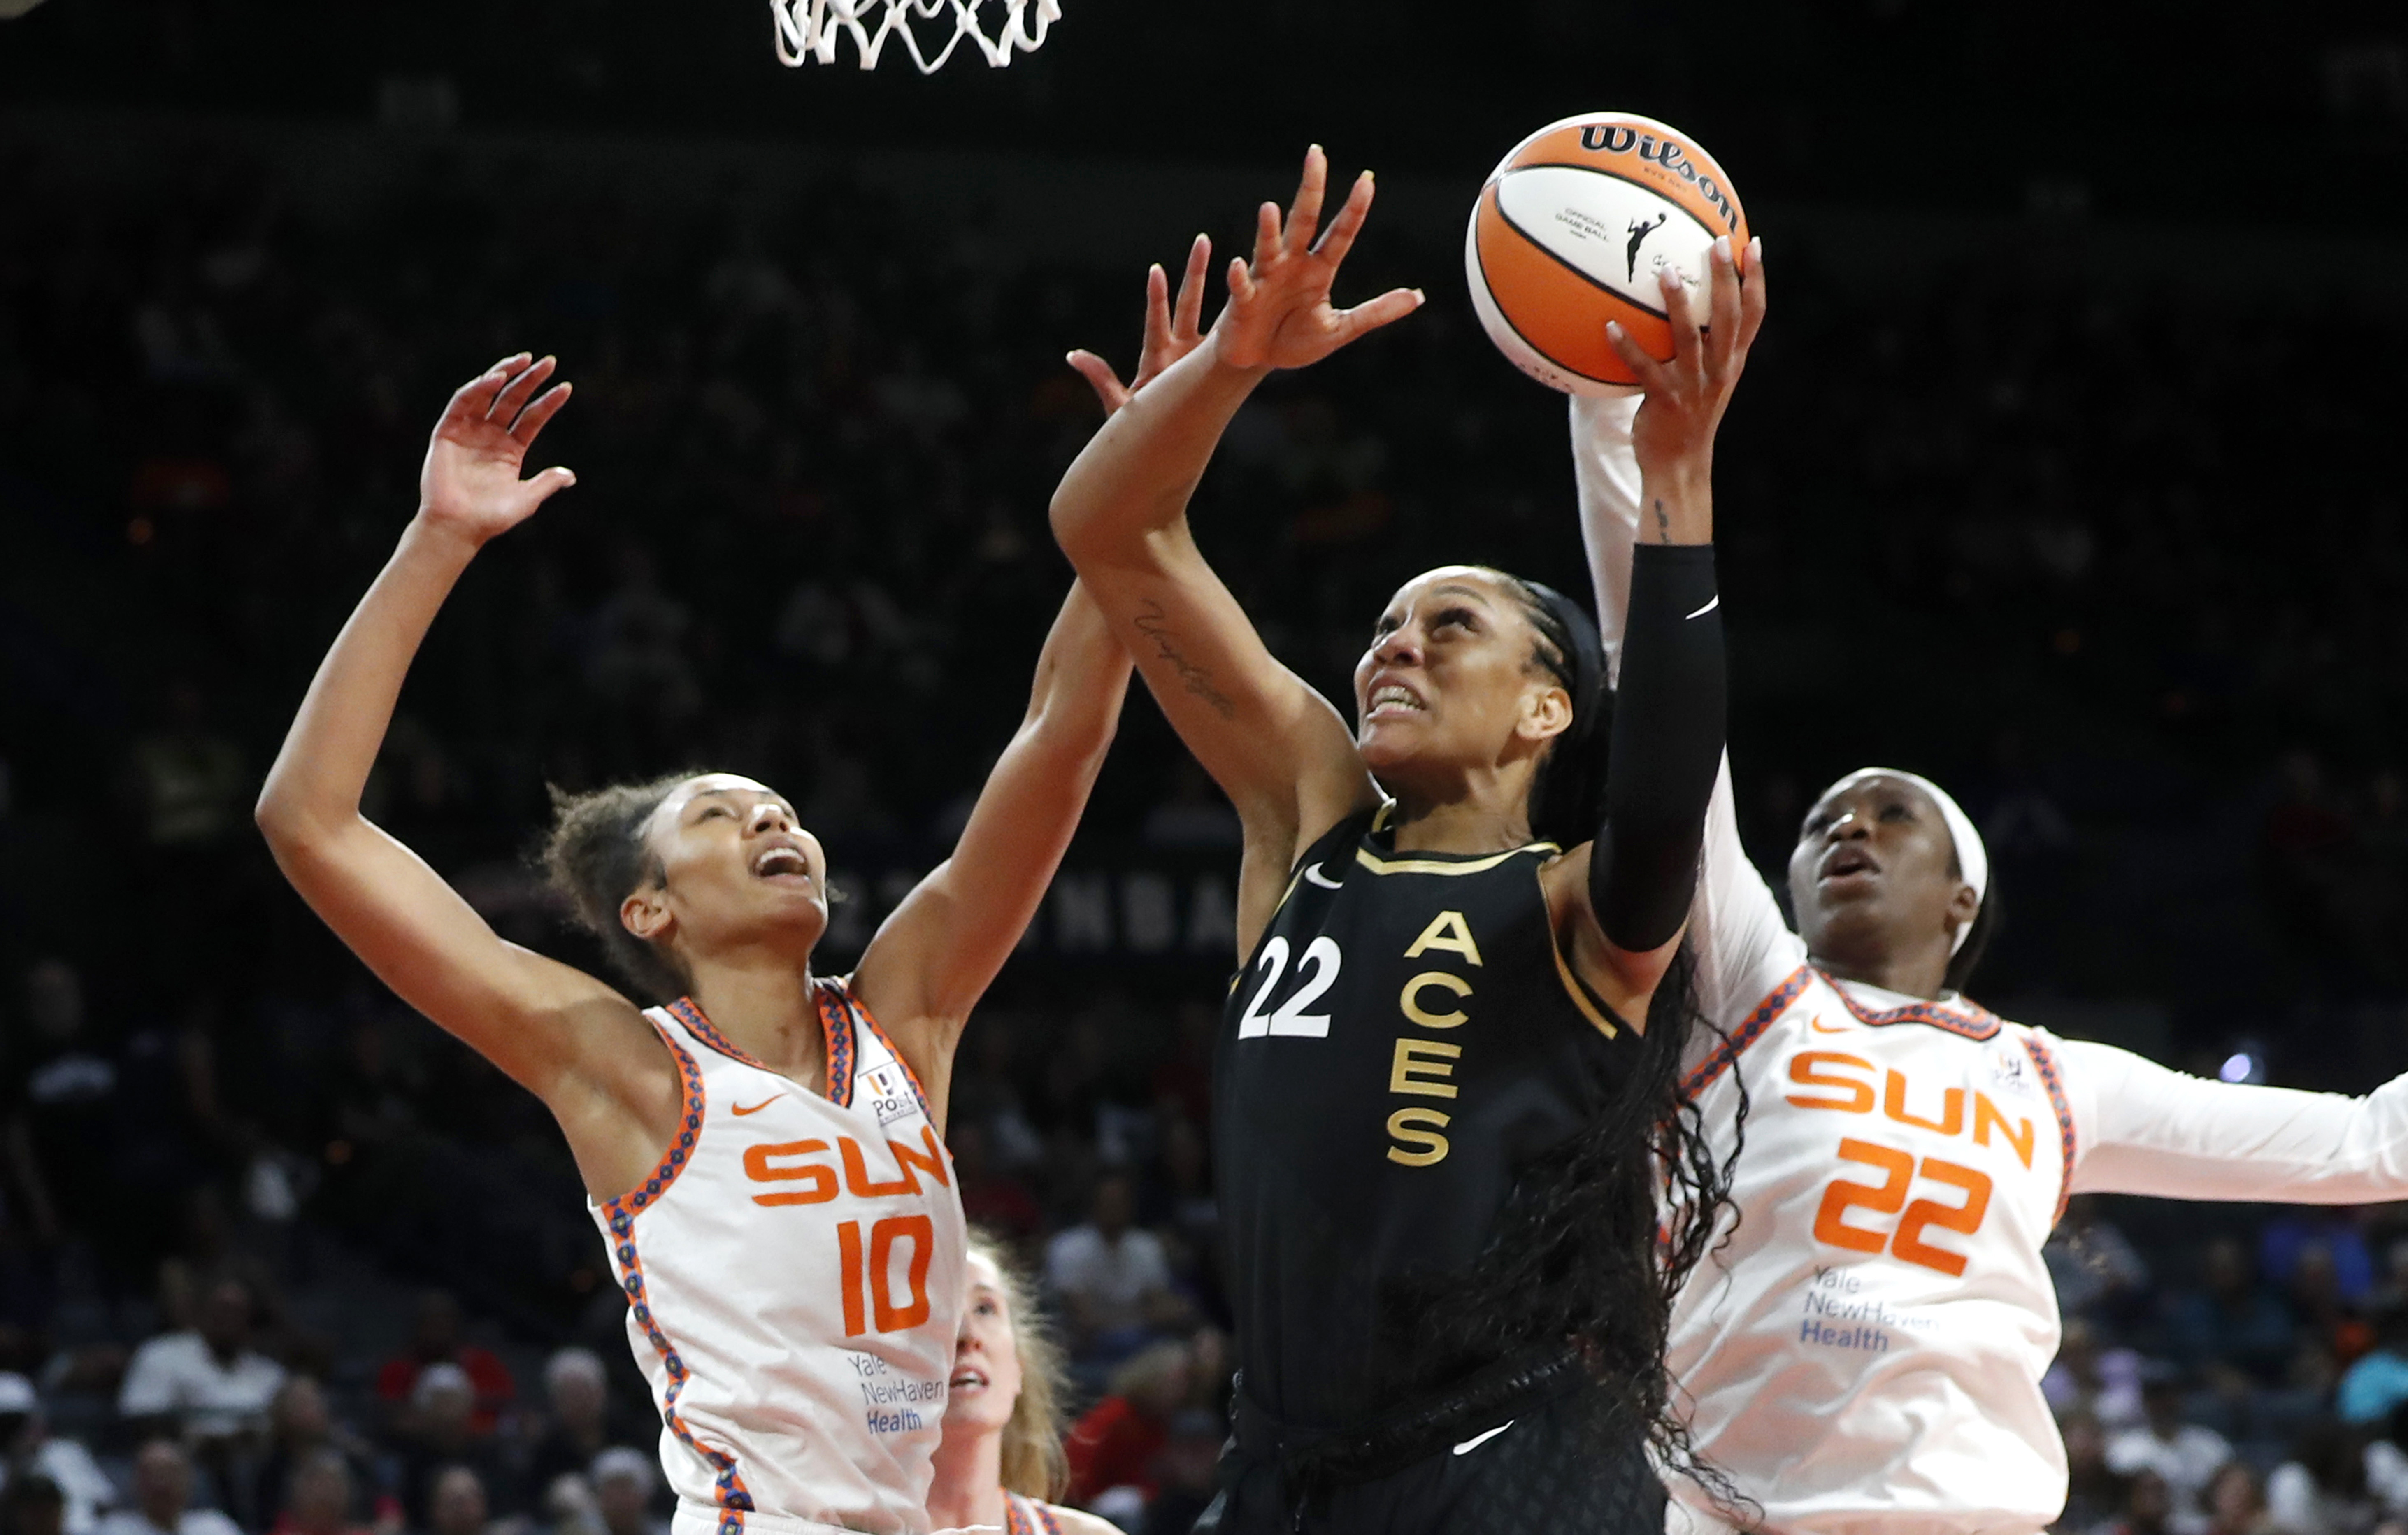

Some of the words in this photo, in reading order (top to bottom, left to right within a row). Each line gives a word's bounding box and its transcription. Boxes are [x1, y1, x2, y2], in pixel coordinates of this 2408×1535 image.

[1580, 125, 1737, 236] Wilson
[1555, 213, 1583, 229] GAME
[1584, 226, 1609, 242] BALL
[1238, 935, 1342, 1040] 22
[1386, 910, 1483, 1167] ACES
[1785, 1050, 2034, 1171] SUN
[1813, 1137, 1993, 1277] 22
[837, 1214, 934, 1337] 10
[1815, 1265, 1861, 1293] Yale
[1804, 1291, 1940, 1331] NewHaven
[1800, 1318, 1888, 1352] Health
[848, 1353, 886, 1376] Yale
[861, 1379, 944, 1406] NewHaven
[867, 1407, 922, 1435] Health
